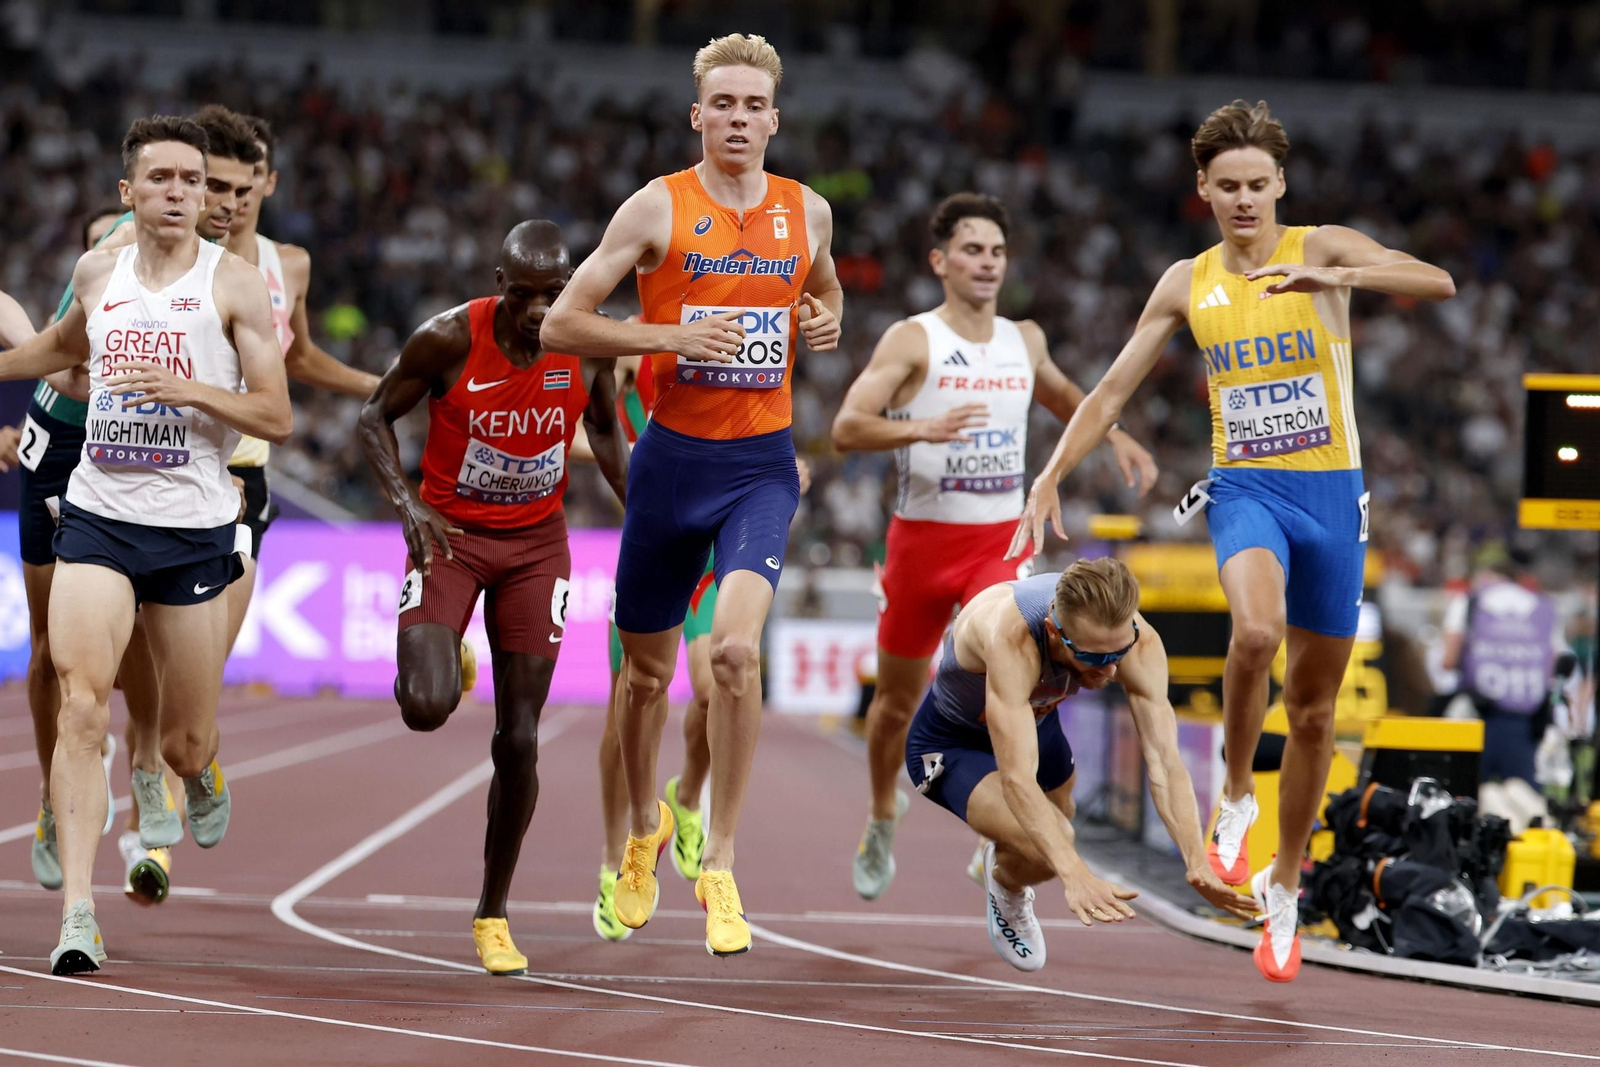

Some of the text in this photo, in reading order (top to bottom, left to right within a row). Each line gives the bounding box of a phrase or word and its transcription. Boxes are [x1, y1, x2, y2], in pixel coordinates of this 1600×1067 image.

[682, 252, 798, 276] Nederland
[105, 329, 186, 355] GREAT
[686, 340, 783, 365] ROS
[938, 375, 1029, 391] FRANCE
[1245, 376, 1317, 407] TDK
[90, 418, 186, 448] WIGHTMAN
[470, 406, 565, 437] KENYA
[1228, 405, 1325, 441] PIHLSTRÖM
[21, 426, 38, 461] 2
[968, 428, 1018, 451] TDK
[496, 448, 558, 475] TDK
[945, 452, 1020, 475] MORNET
[465, 463, 561, 491] T. CHERUIYOT
